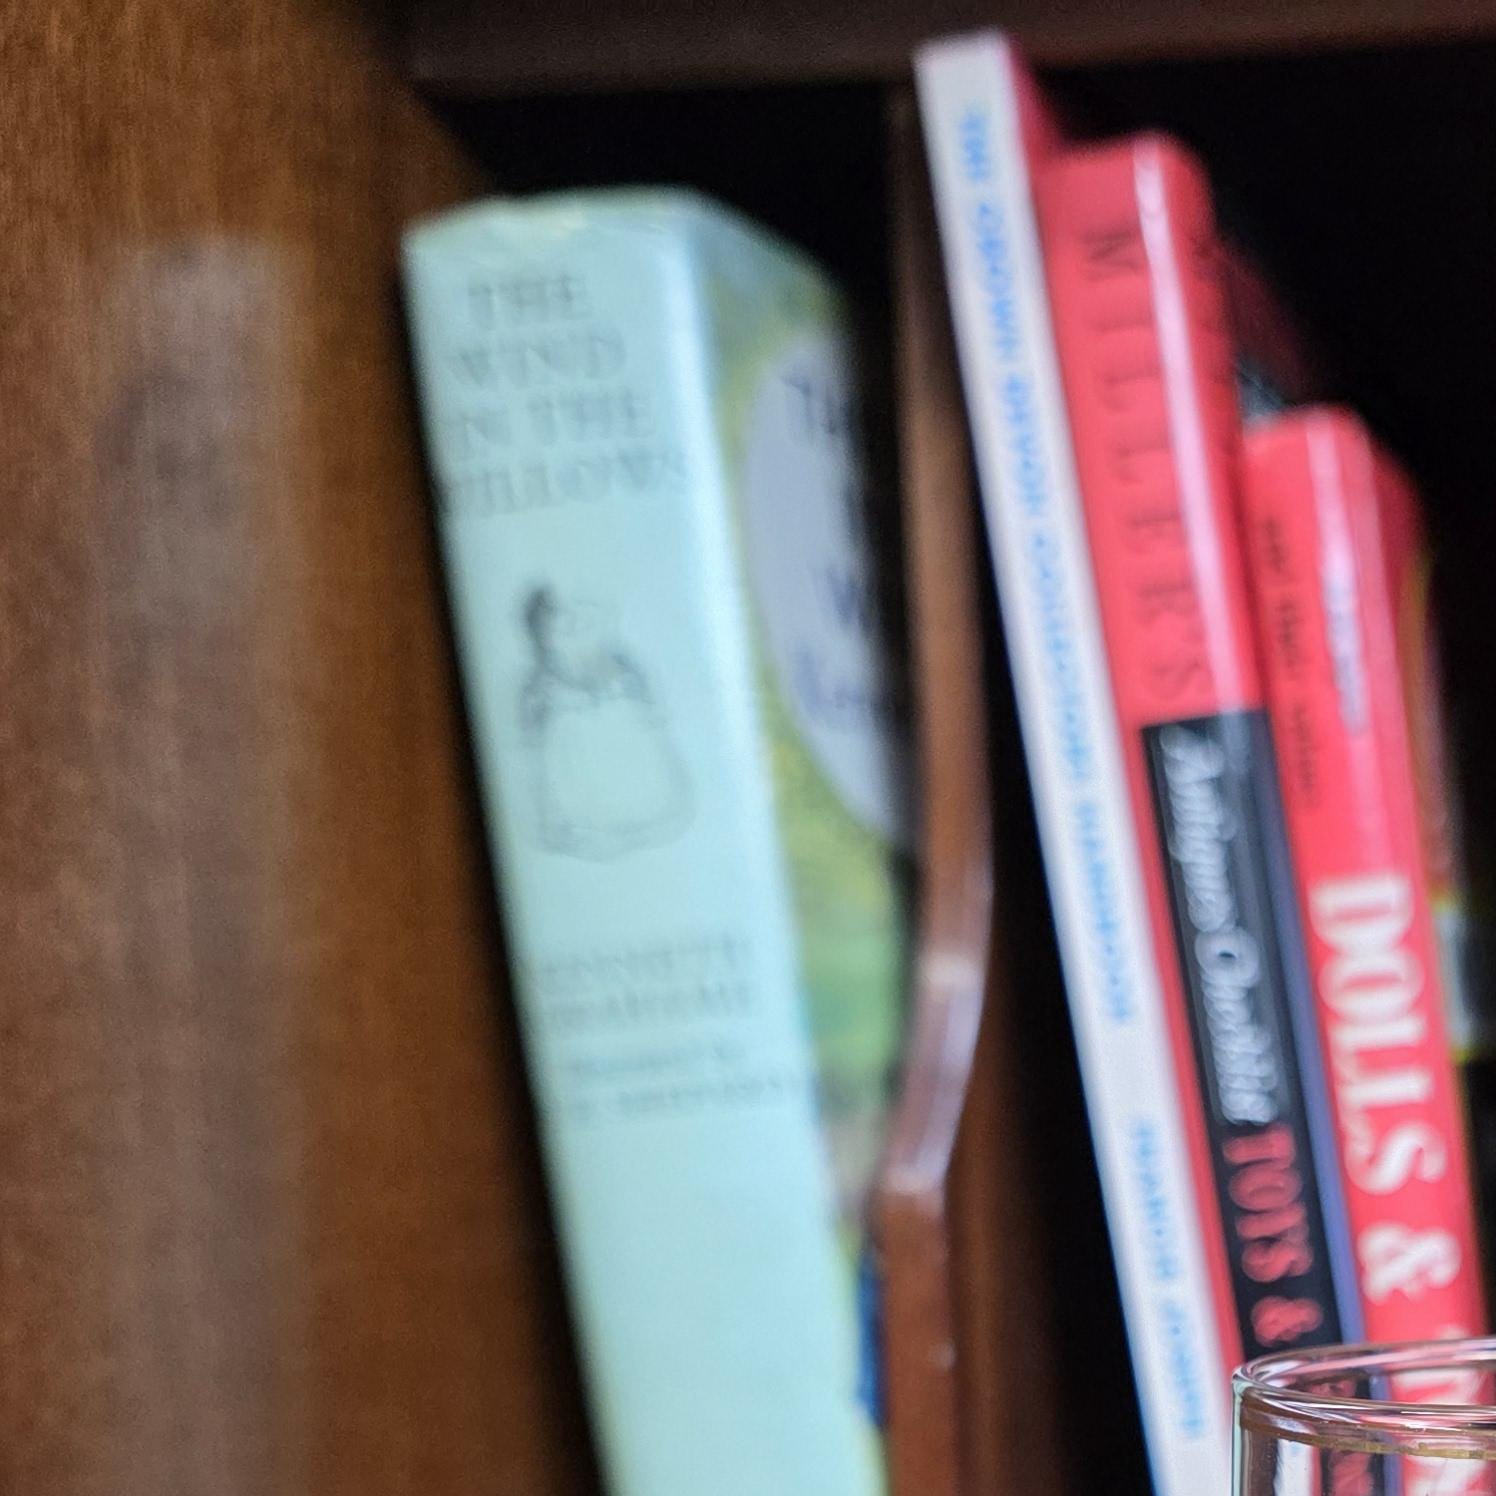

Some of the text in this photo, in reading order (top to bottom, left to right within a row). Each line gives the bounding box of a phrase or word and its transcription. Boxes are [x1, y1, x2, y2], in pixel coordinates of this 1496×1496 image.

[1308, 870, 1449, 1195] DOLLS
[1221, 1125, 1314, 1283] TOYS
[1356, 1221, 1463, 1304] &
[1250, 1295, 1323, 1348] &
